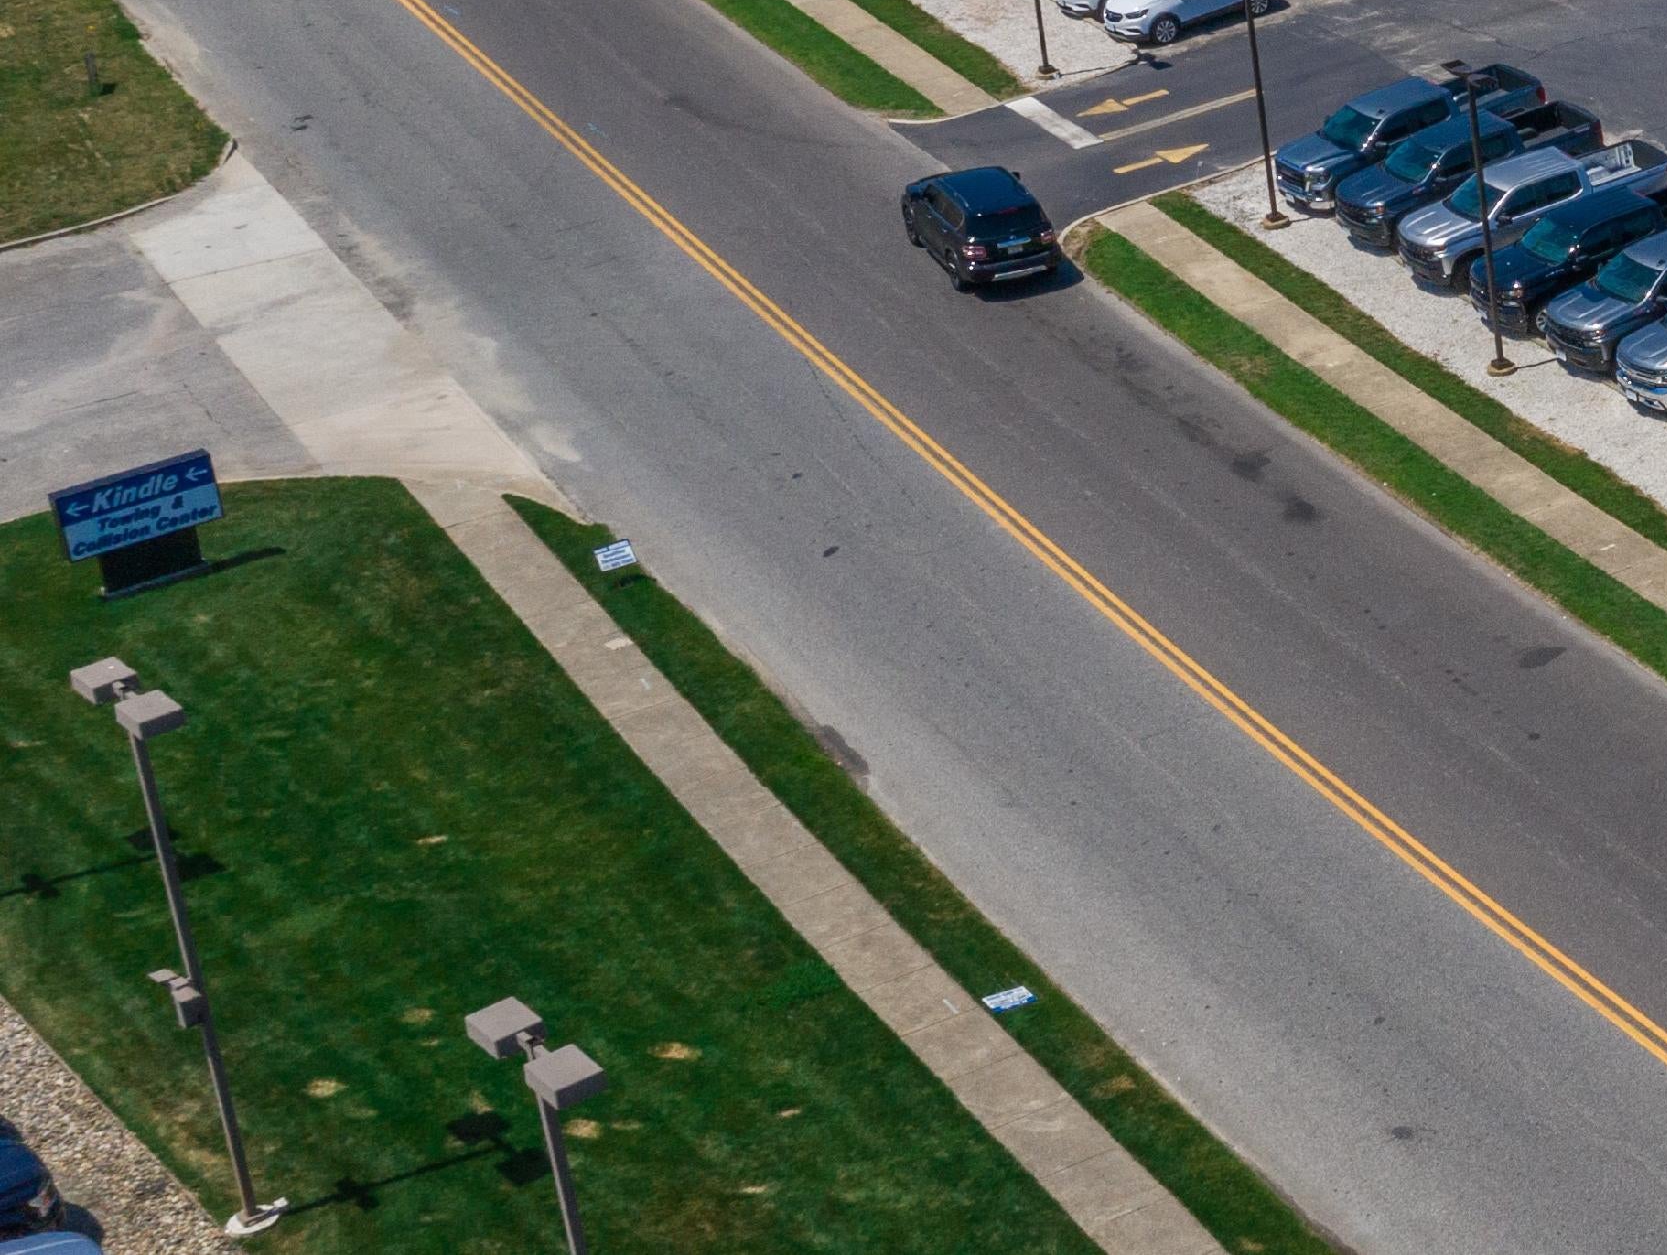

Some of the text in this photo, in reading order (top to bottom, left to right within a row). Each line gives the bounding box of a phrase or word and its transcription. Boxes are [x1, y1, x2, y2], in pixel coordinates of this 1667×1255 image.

[91, 472, 179, 514] Kindle
[72, 503, 218, 557] Collision Center
[97, 504, 162, 532] Towing
